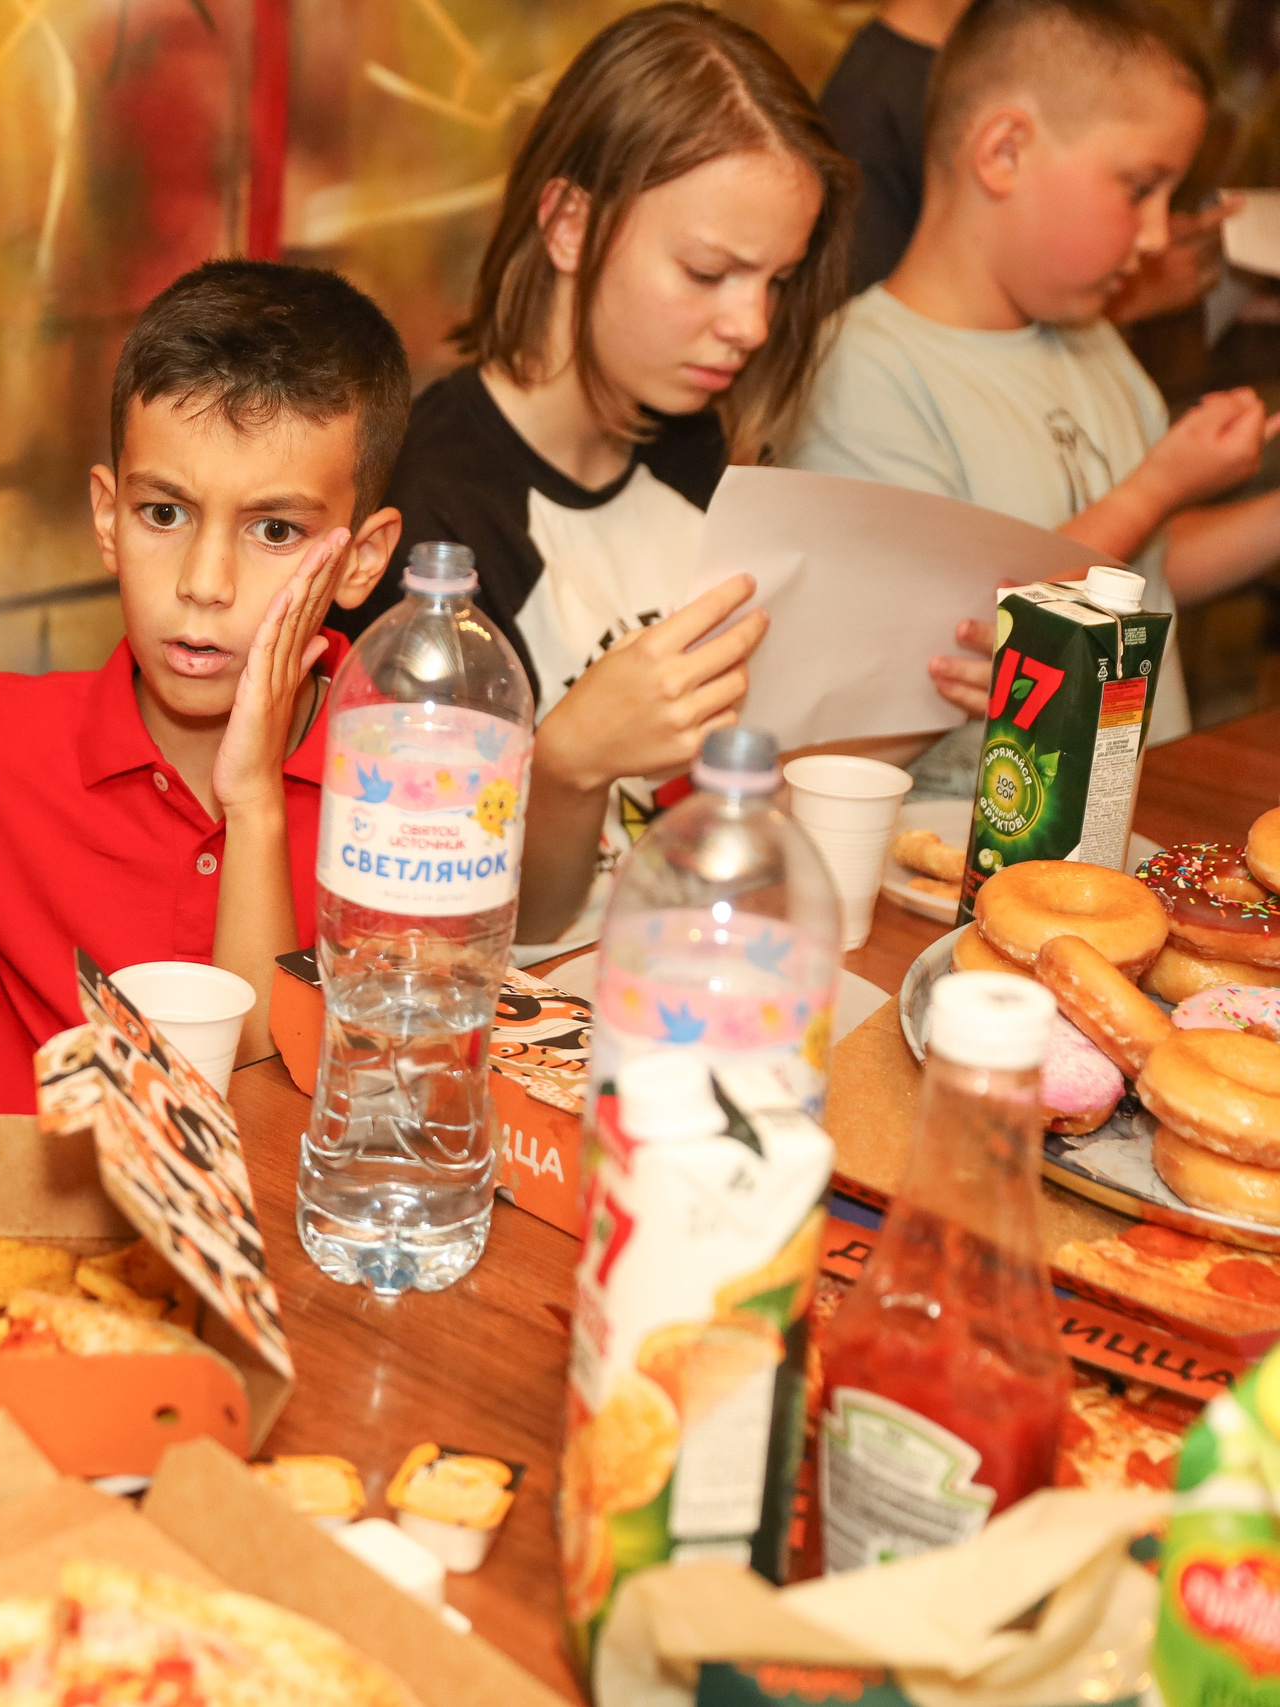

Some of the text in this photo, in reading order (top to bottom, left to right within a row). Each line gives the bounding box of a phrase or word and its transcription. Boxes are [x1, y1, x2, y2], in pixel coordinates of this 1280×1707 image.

[987, 647, 1065, 730] J7
[985, 747, 1032, 785] ЗАРЯЖАЙСЯ
[988, 797, 1018, 820] ЭНЕРГИЕЙ
[996, 786, 1013, 801] СОК
[400, 823, 460, 837] СВЯТОЙ
[980, 797, 1027, 832] ФРУКТОВ!
[390, 835, 467, 850] ИСТОЧНИК
[342, 844, 510, 883] СВЕТЛЯЧОК
[1061, 1317, 1237, 1392] ИЦЦА
